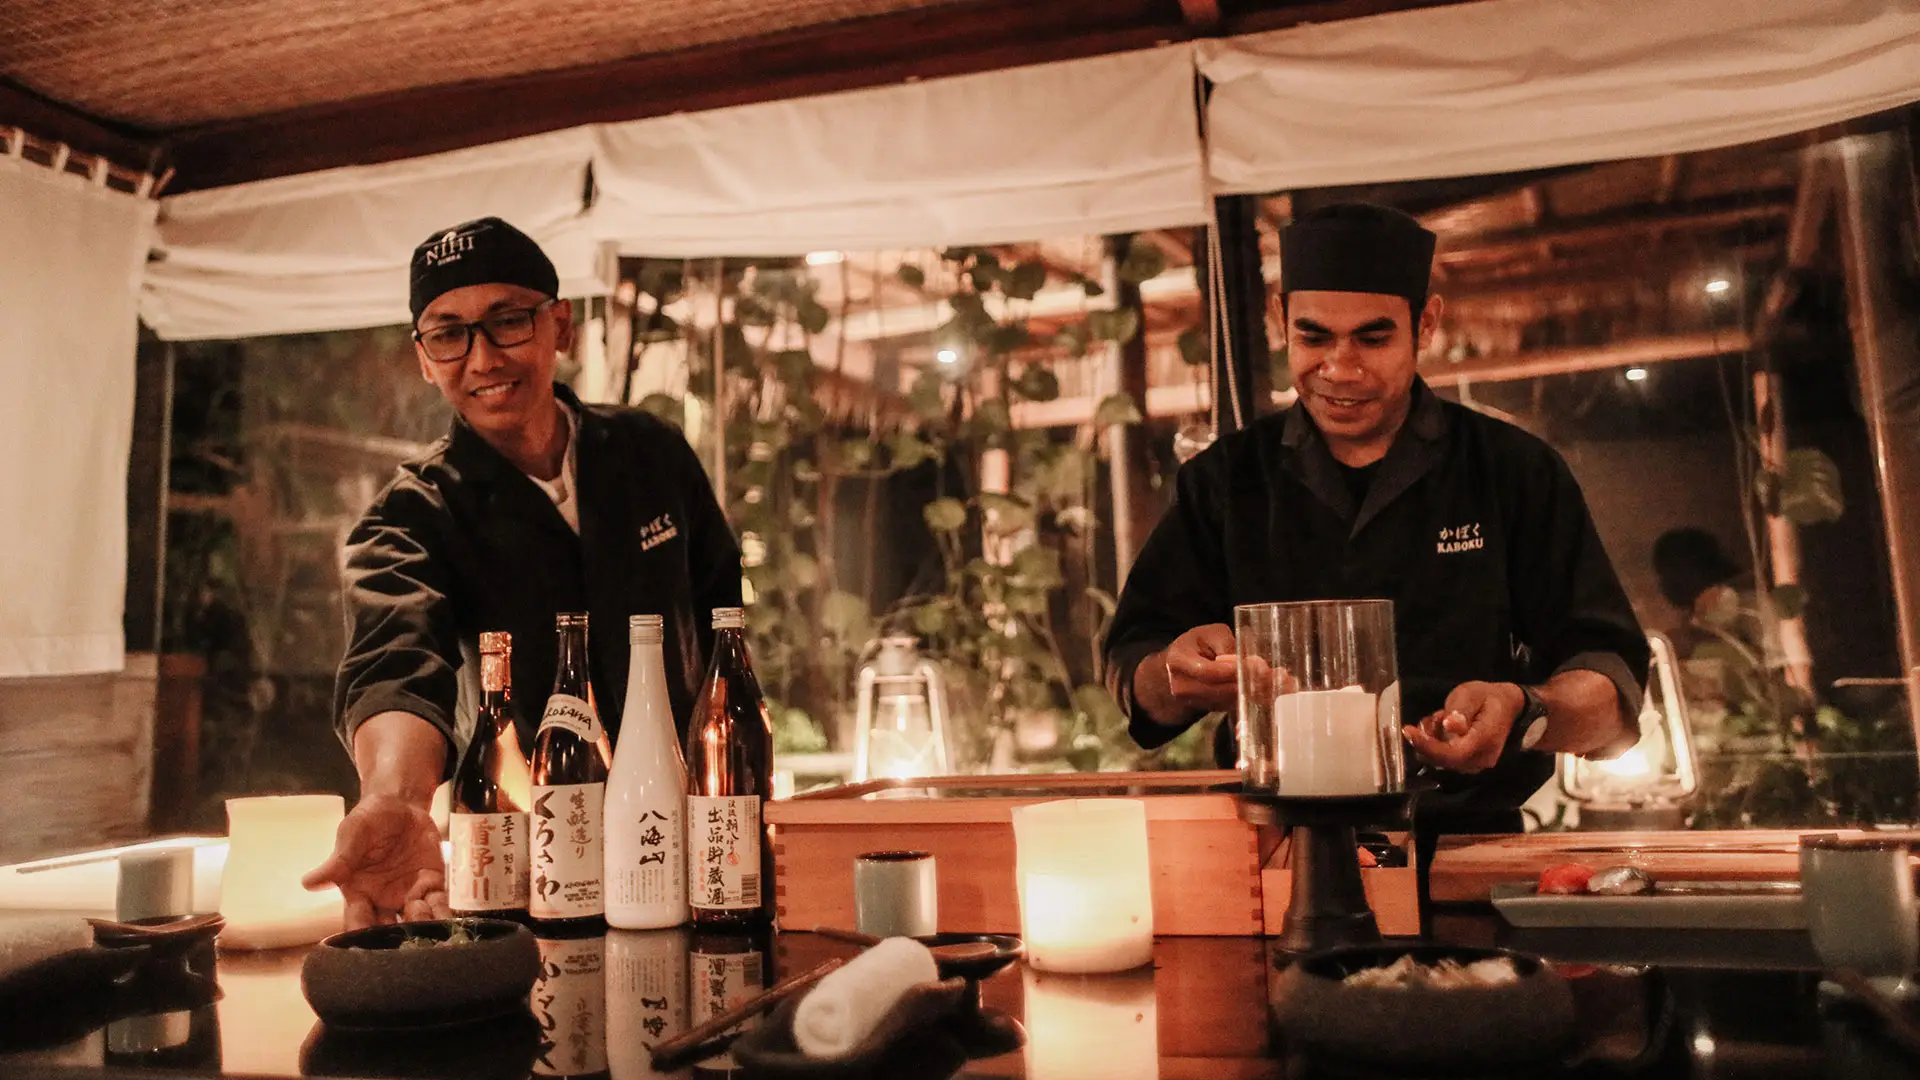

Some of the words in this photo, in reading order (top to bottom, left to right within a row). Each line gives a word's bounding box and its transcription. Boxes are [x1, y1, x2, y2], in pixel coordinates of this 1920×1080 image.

[426, 233, 475, 266] NIHI
[1437, 537, 1484, 553] KABOKU
[1439, 522, 1480, 541] かぼく
[501, 815, 515, 847] 三十三
[534, 789, 561, 902] くろさわ
[639, 809, 669, 866] 八海山
[707, 806, 725, 905] 出品貯蔵酒
